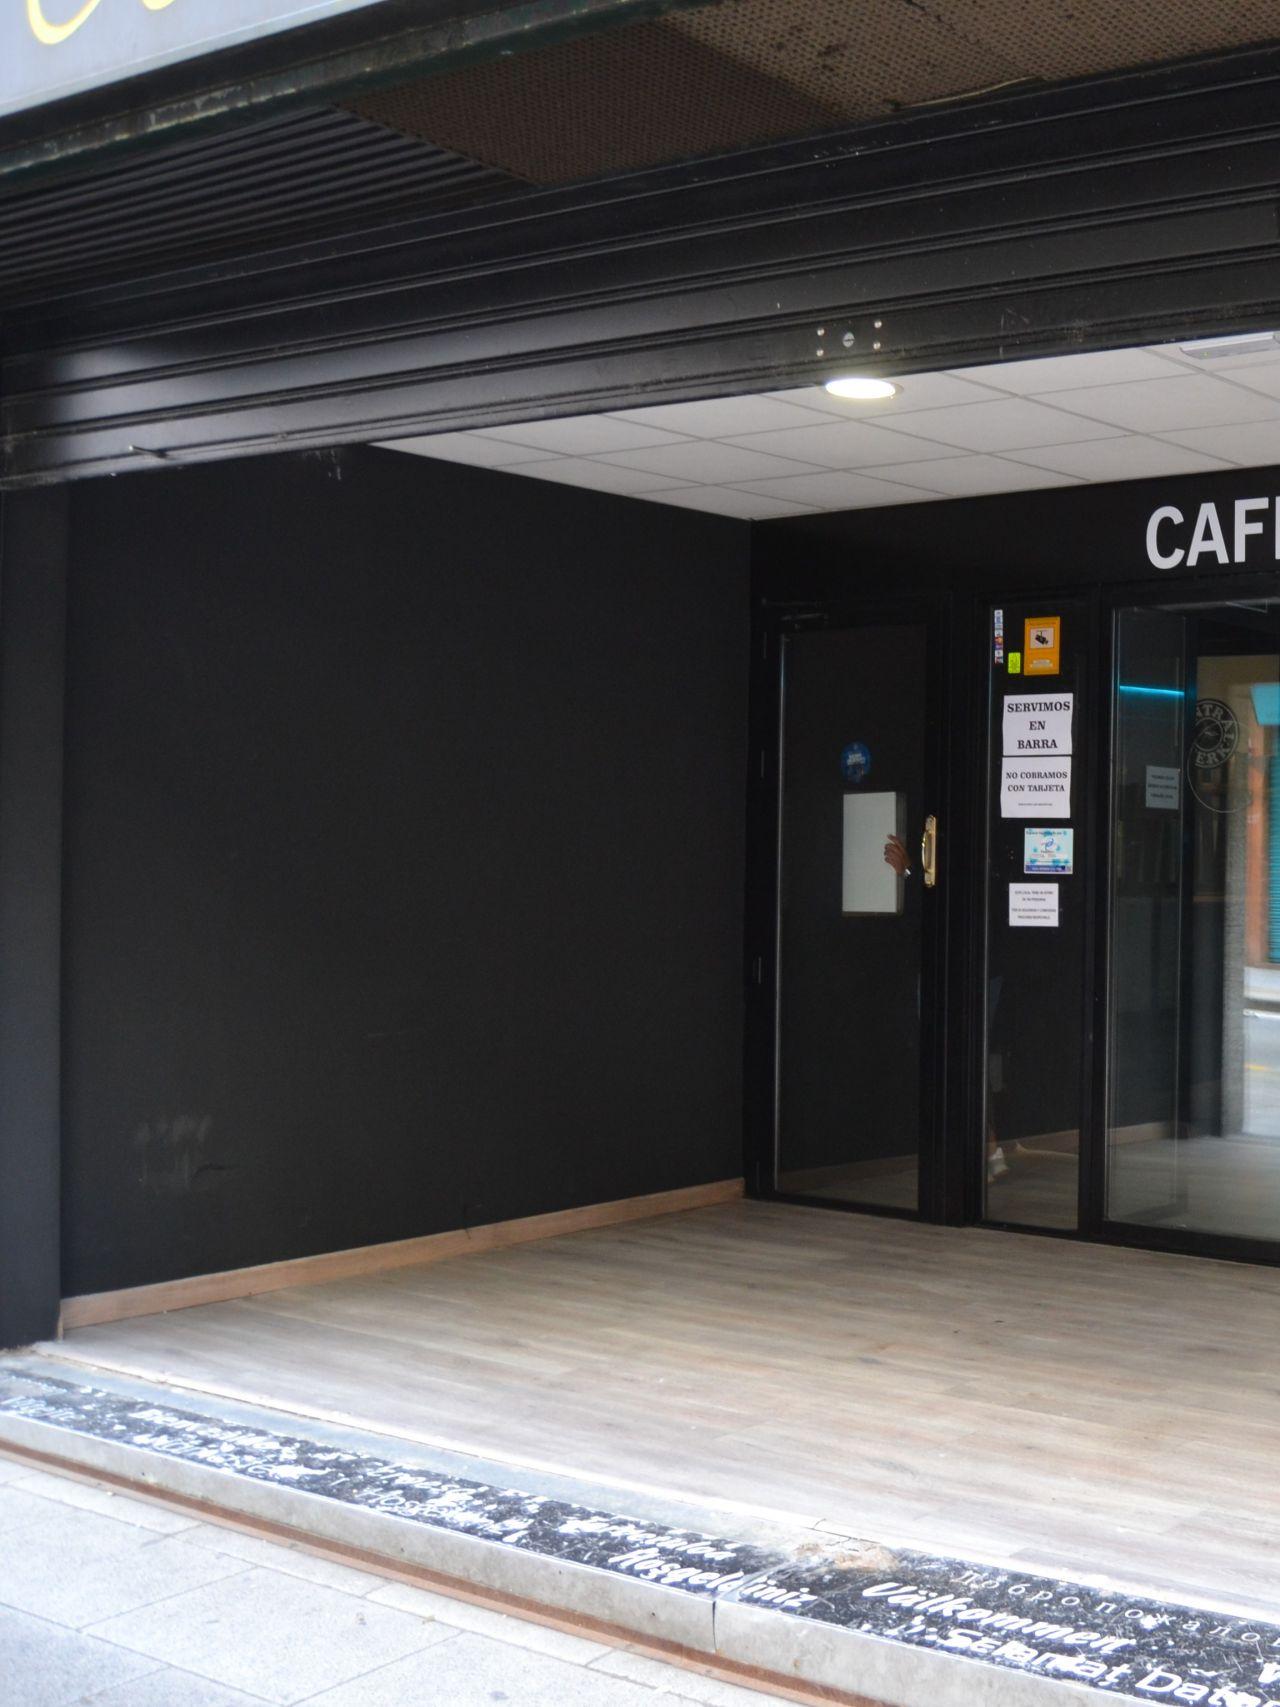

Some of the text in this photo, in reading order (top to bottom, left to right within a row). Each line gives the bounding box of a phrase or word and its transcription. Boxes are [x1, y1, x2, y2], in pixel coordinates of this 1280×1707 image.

[1007, 701, 1071, 713] SERVIMOS
[1029, 720, 1046, 731] EN
[1017, 739, 1058, 750] BARRA
[1006, 771, 1068, 780] NO COBRAMOS
[1007, 784, 1065, 792] CON TARJETA
[862, 1582, 1137, 1654] Välkommen
